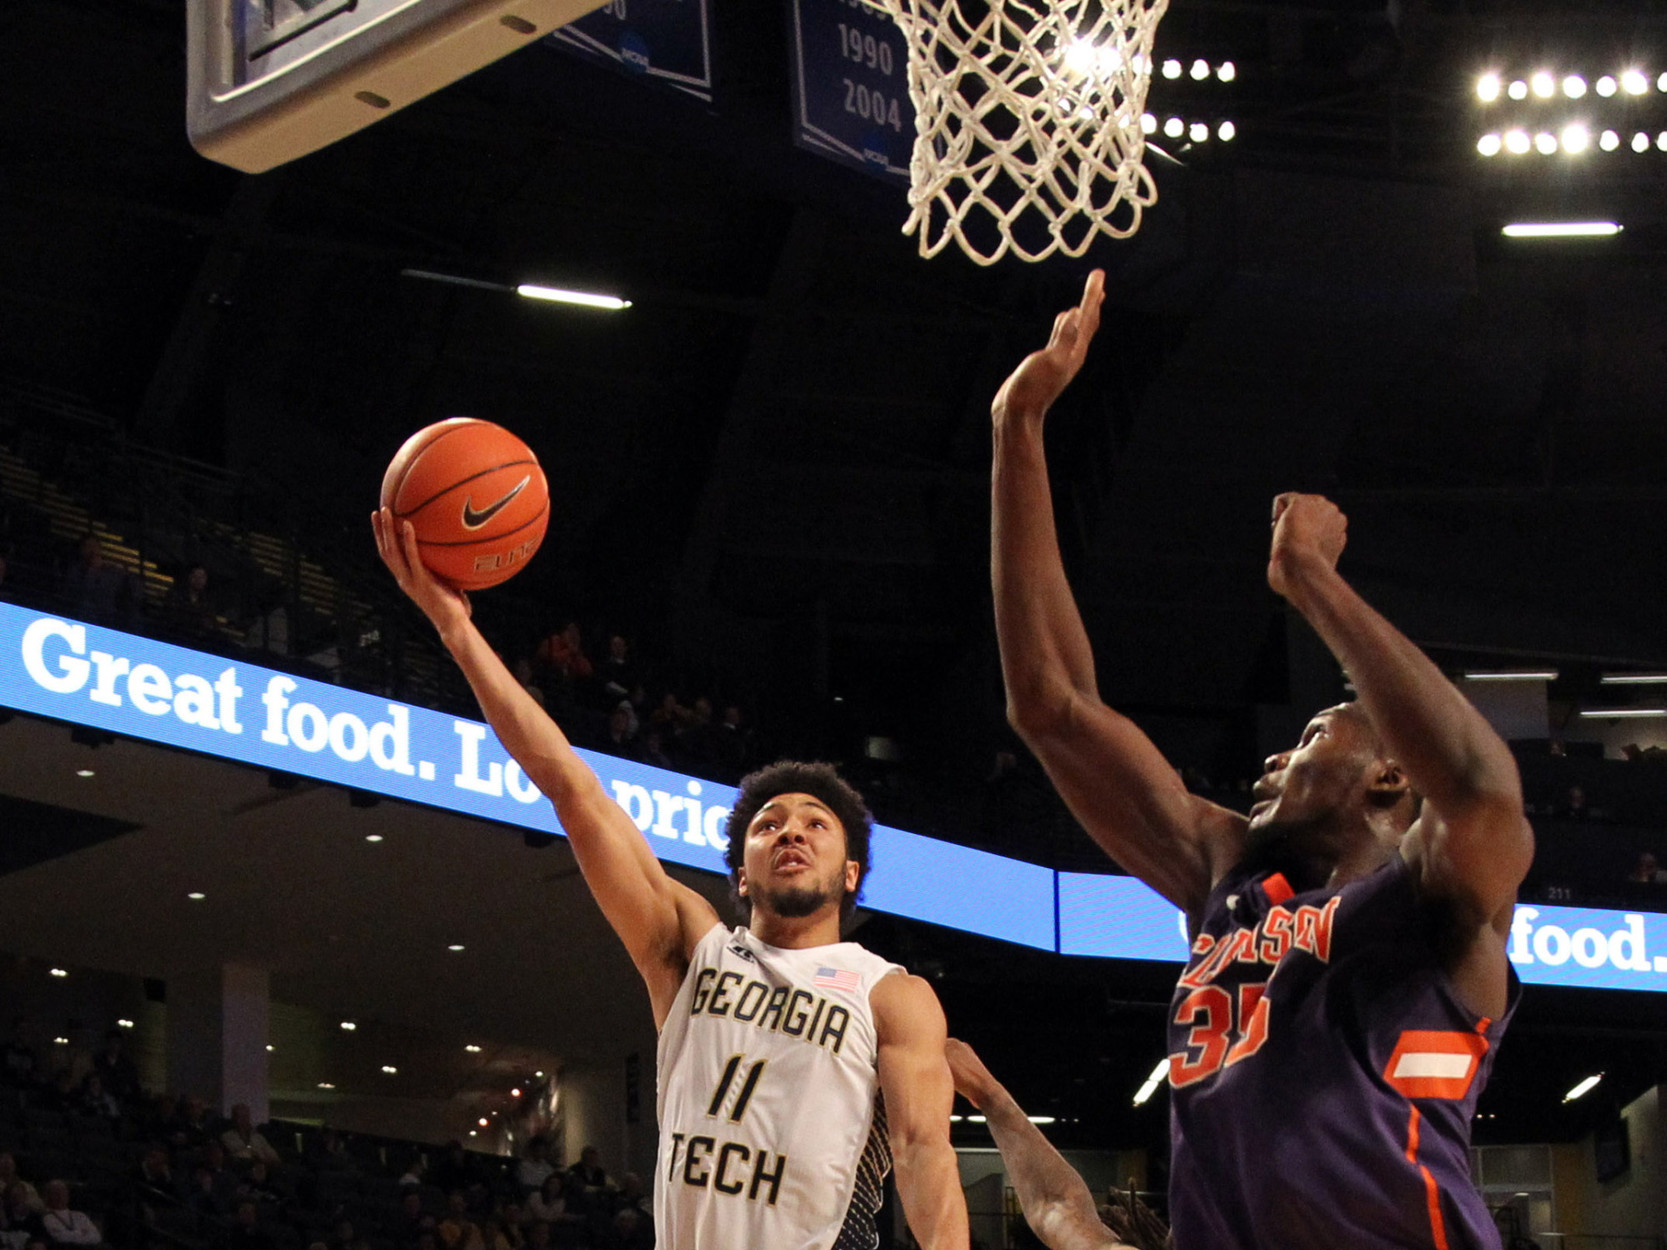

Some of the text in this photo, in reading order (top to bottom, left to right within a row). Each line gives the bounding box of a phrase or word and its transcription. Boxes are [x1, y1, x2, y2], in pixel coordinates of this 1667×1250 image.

[838, 23, 893, 76] 1990
[843, 78, 902, 132] 2004
[21, 617, 243, 735] Great
[262, 675, 436, 781] food.
[454, 720, 548, 804] Lo
[1509, 907, 1667, 973] food.
[690, 967, 853, 1056] GEORGIA
[706, 1052, 769, 1126] 11
[669, 1131, 788, 1208] TECH
